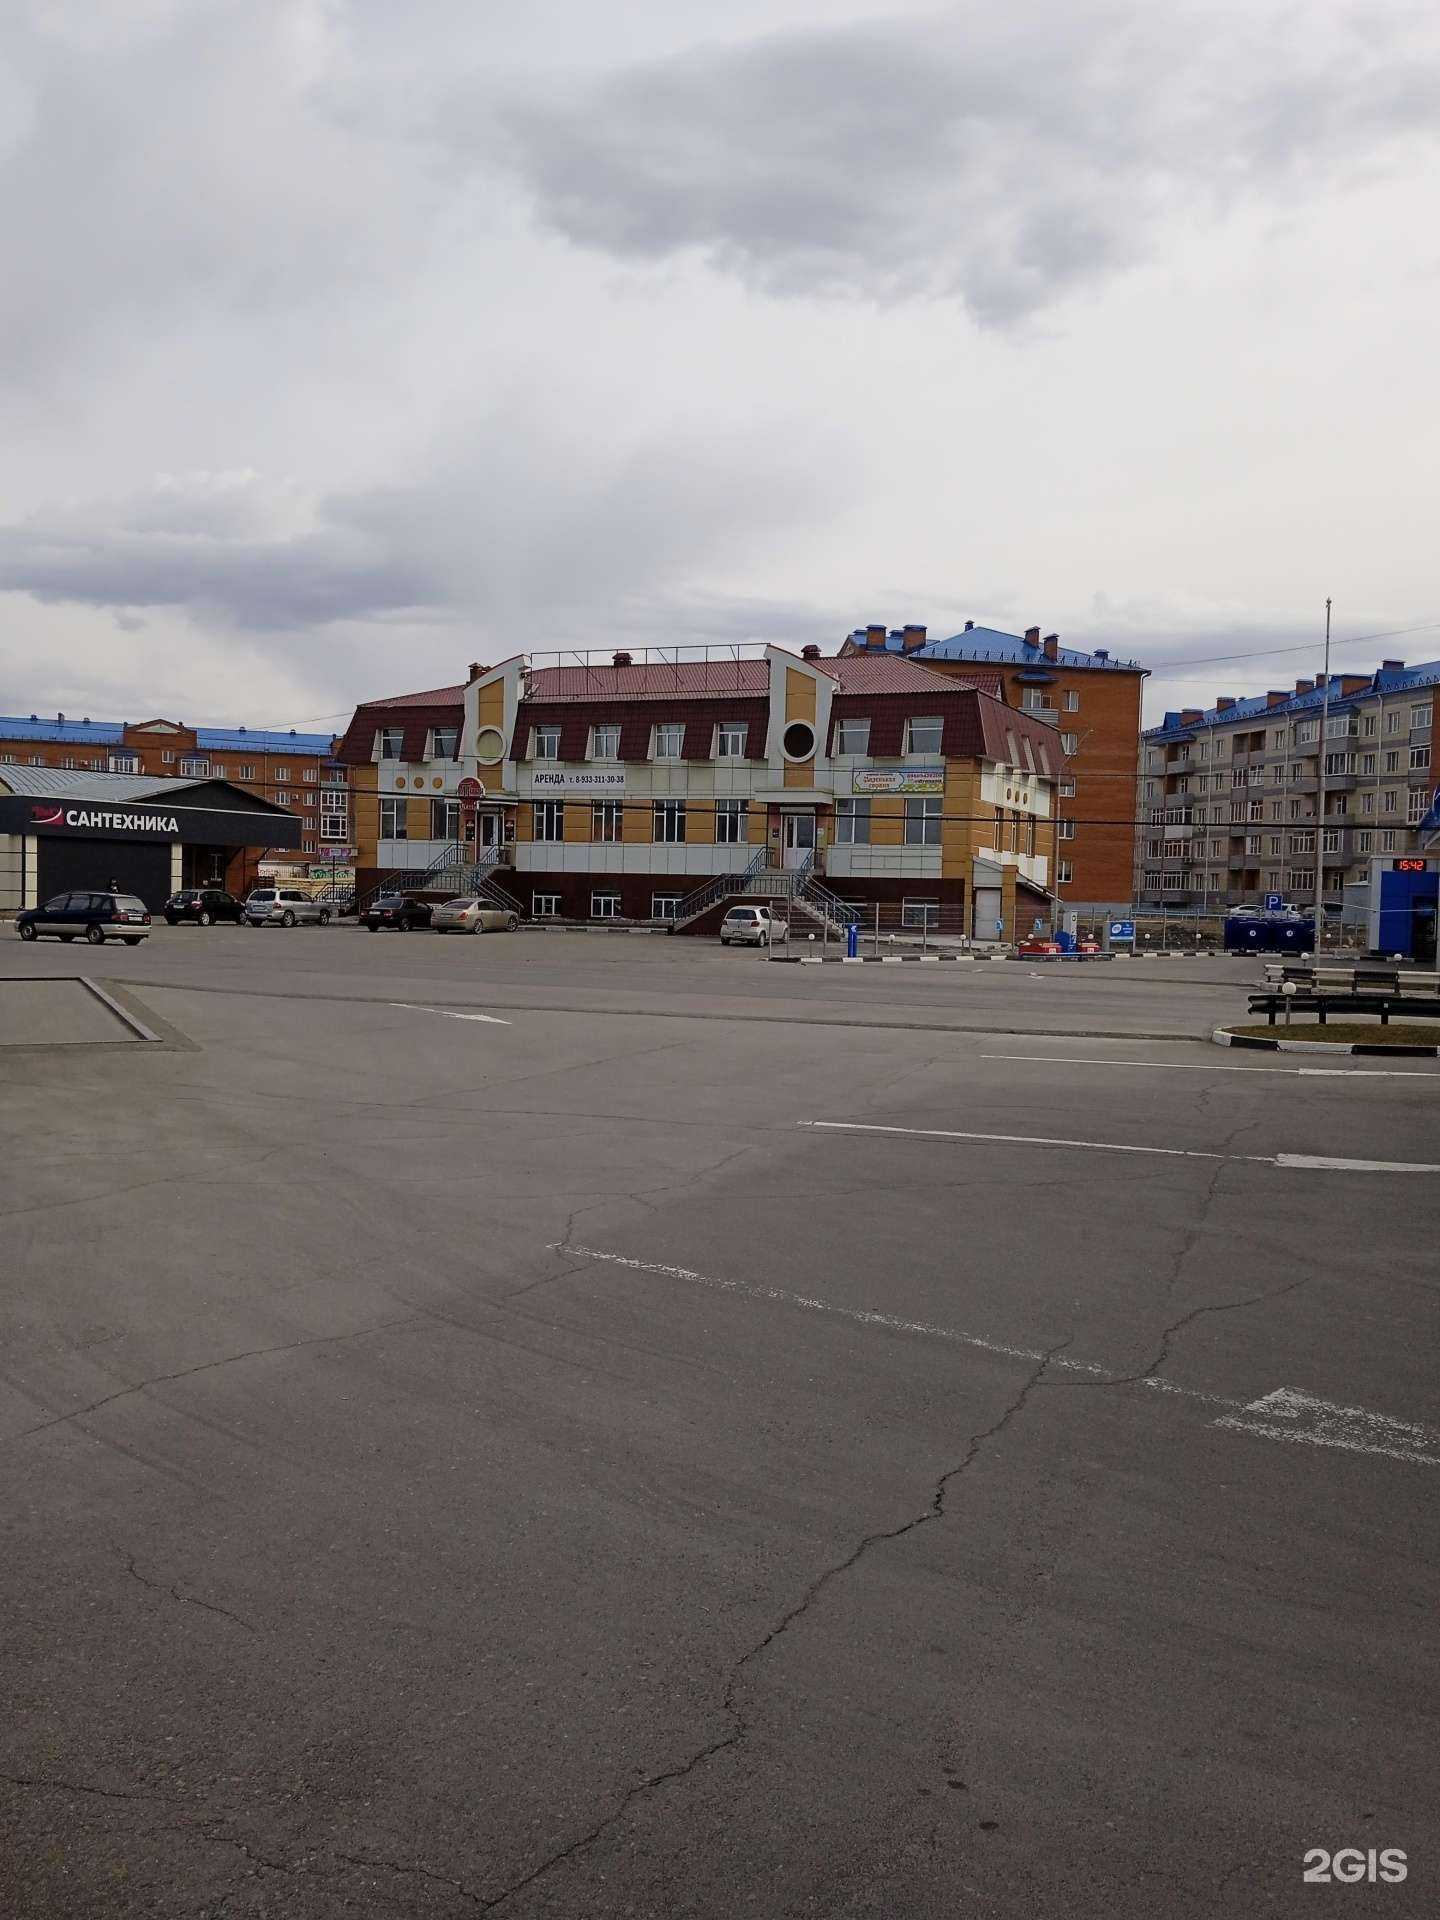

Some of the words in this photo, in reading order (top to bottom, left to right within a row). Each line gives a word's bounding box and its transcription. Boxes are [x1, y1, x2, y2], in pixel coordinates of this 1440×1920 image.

[535, 774, 564, 784] АРЕНДА
[66, 810, 179, 832] САНТЕХНИКА
[1400, 860, 1424, 871] 15:42
[1268, 896, 1279, 908] P
